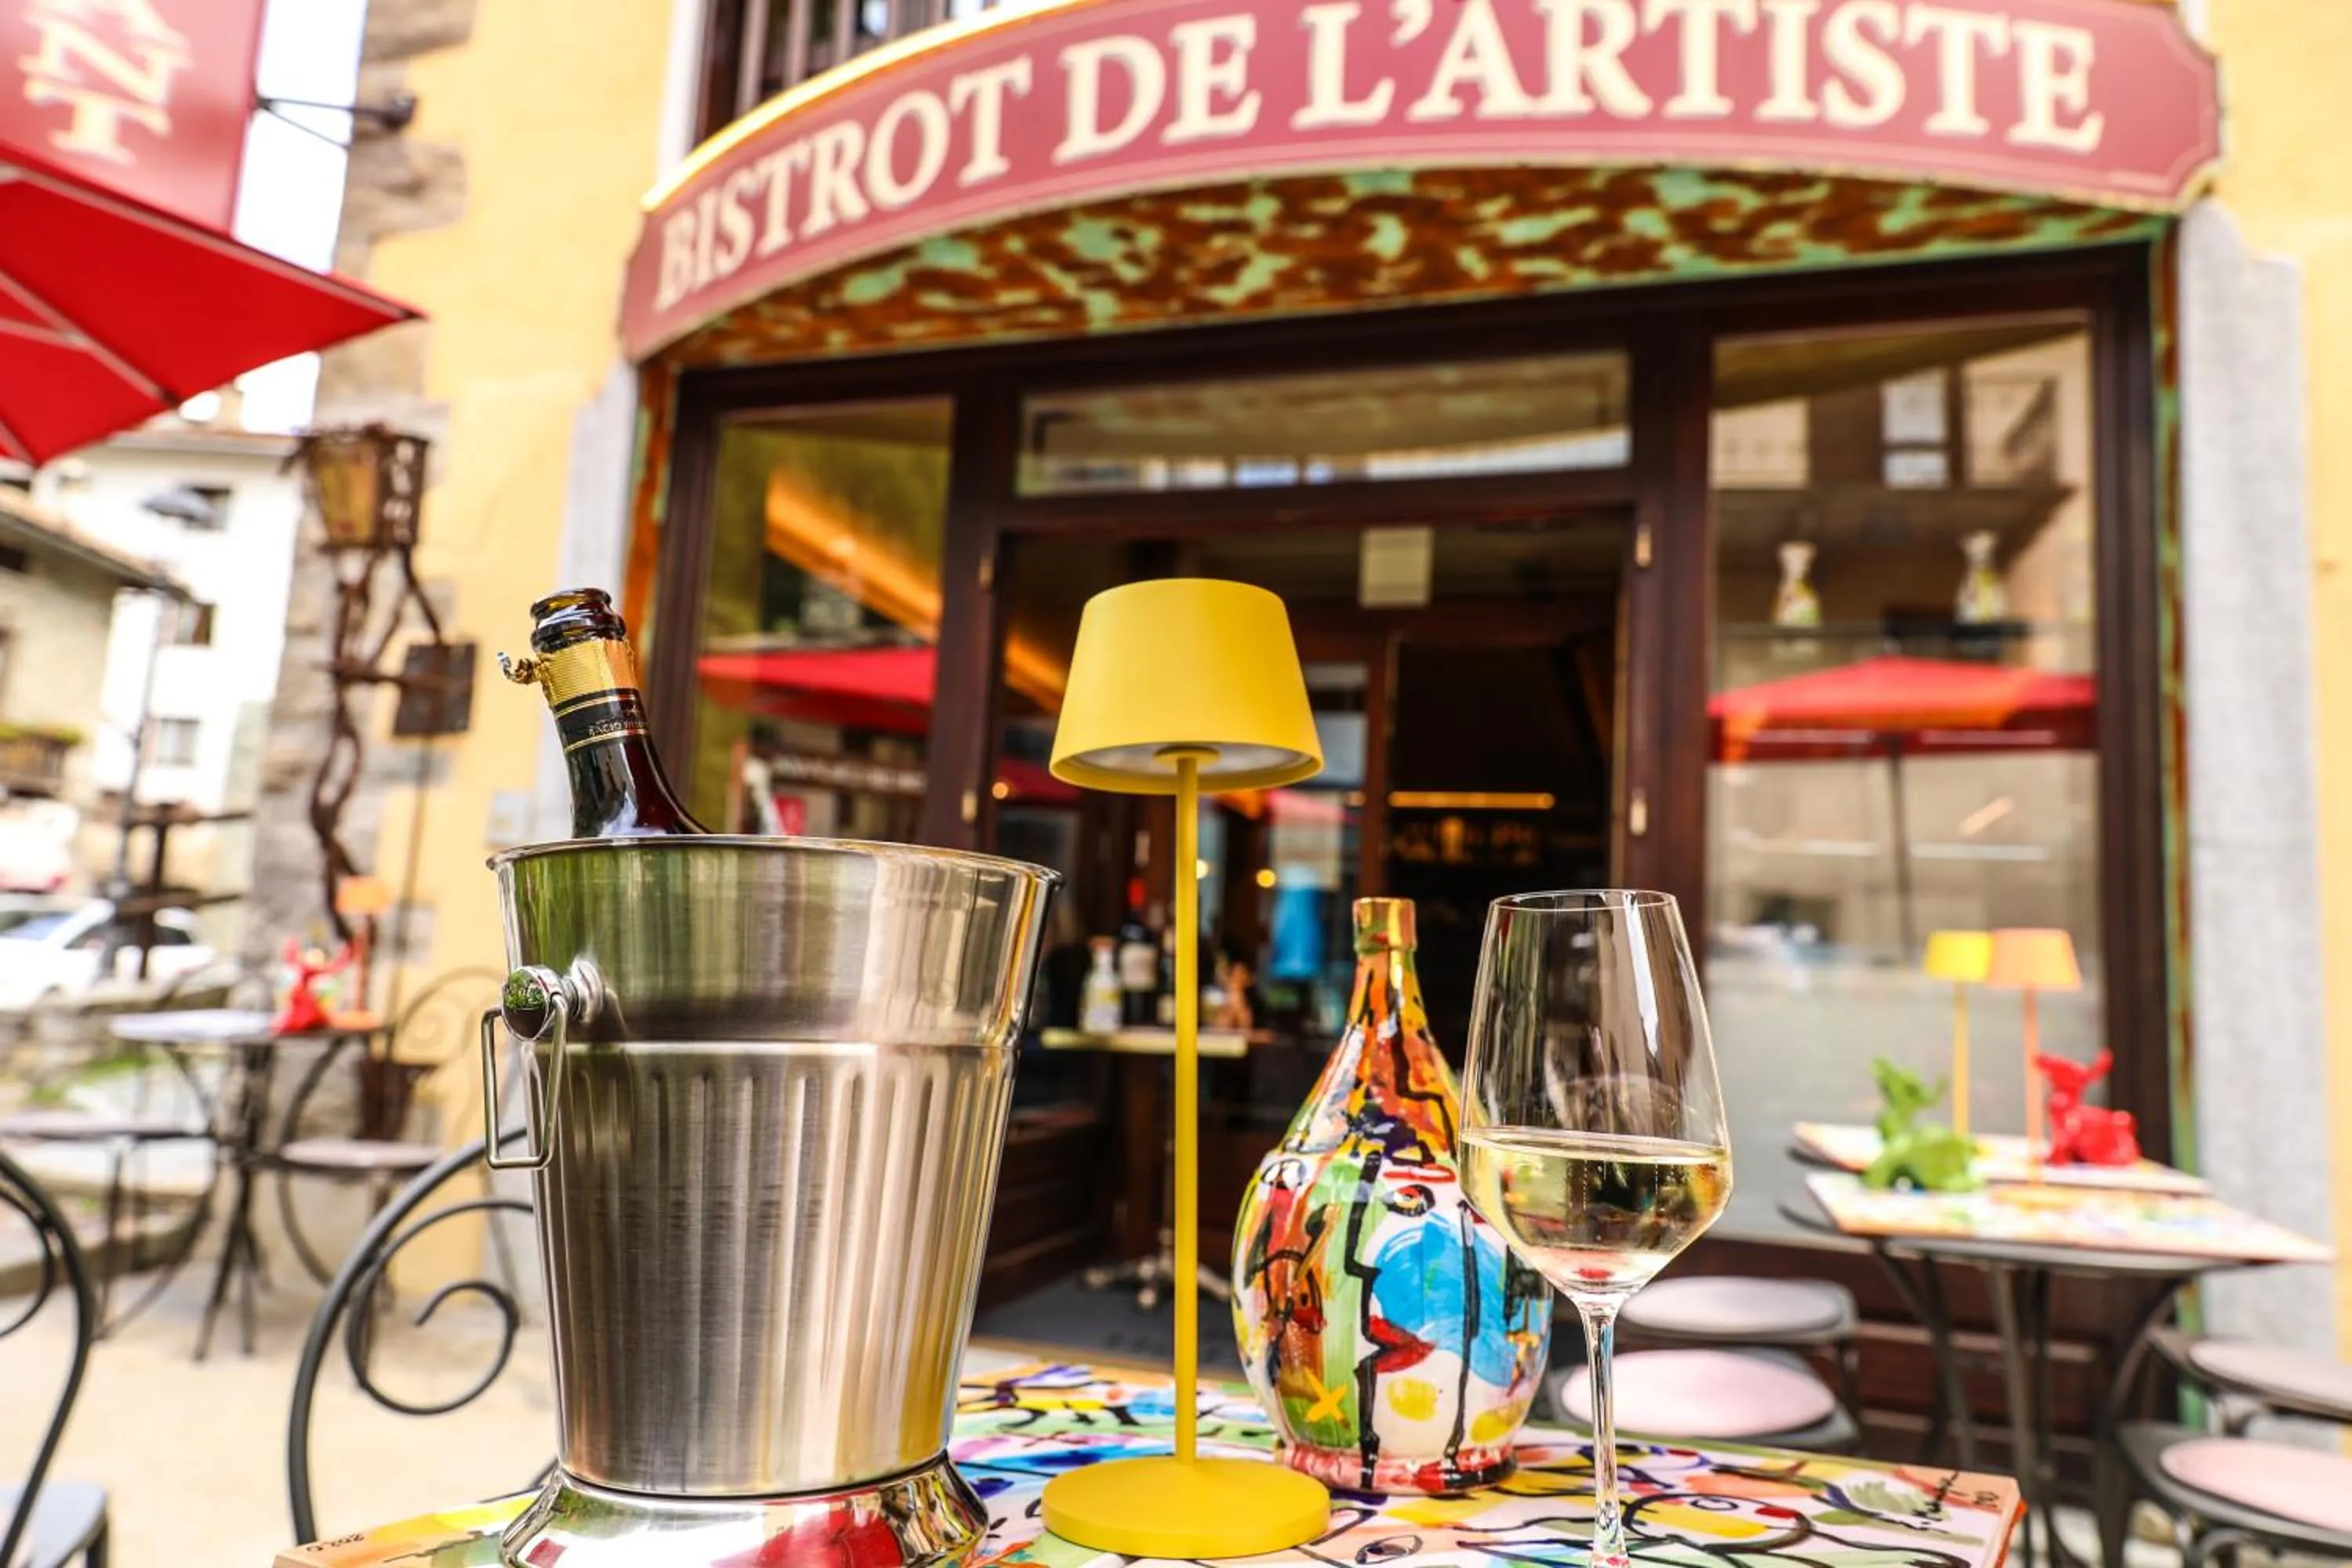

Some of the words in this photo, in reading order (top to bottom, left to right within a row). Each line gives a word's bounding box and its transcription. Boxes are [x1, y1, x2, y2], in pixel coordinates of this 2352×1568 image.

[654, 55, 1033, 312] BISTROT
[1051, 14, 1262, 165] DE
[1290, 0, 2106, 152] L'ARTISTE
